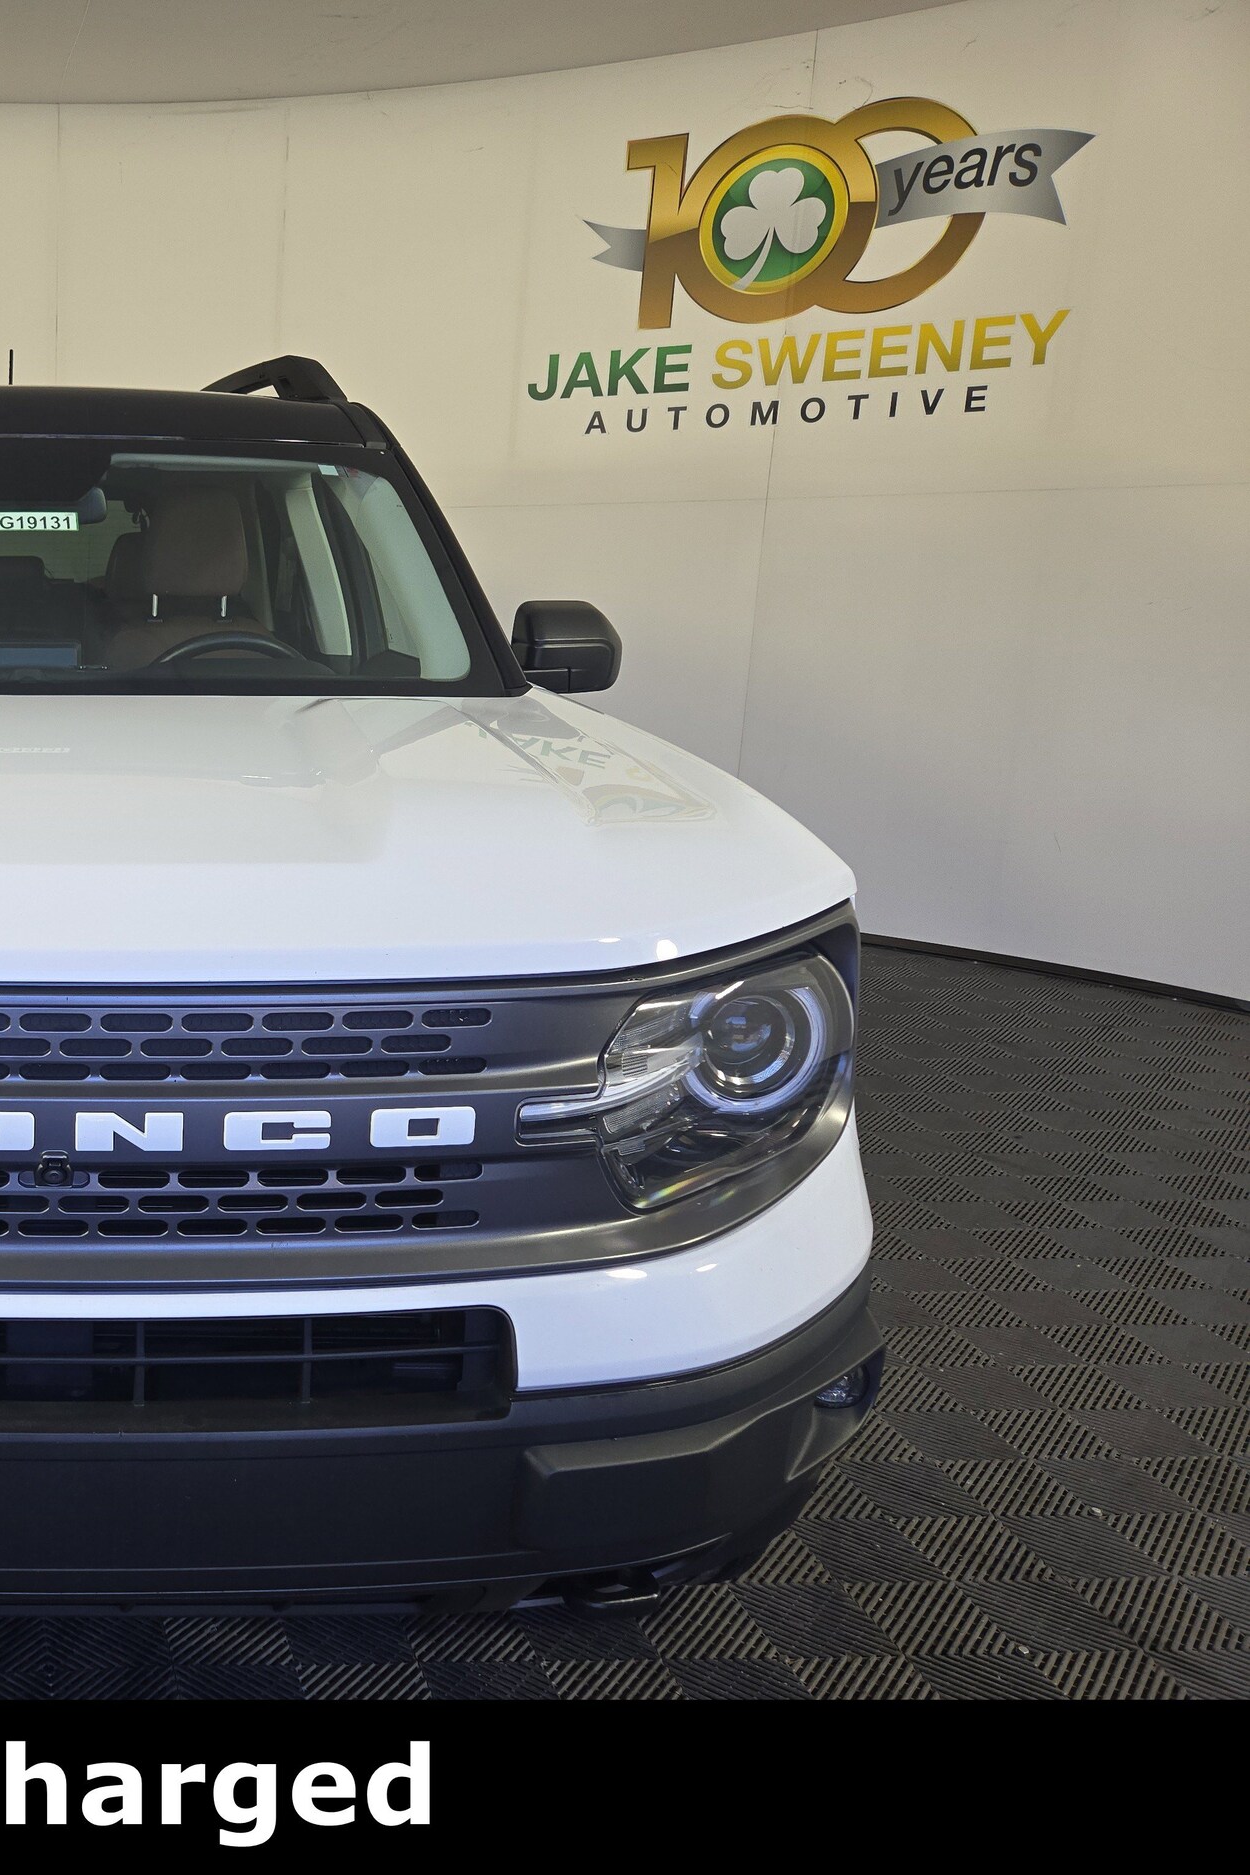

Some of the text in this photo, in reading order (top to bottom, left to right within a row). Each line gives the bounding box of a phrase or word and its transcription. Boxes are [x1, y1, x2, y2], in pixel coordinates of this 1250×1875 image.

[887, 141, 1043, 217] years
[528, 309, 1071, 401] JAKE SWEENEY
[585, 385, 988, 434] AUTOMOTIVE
[0, 516, 71, 530] G19131
